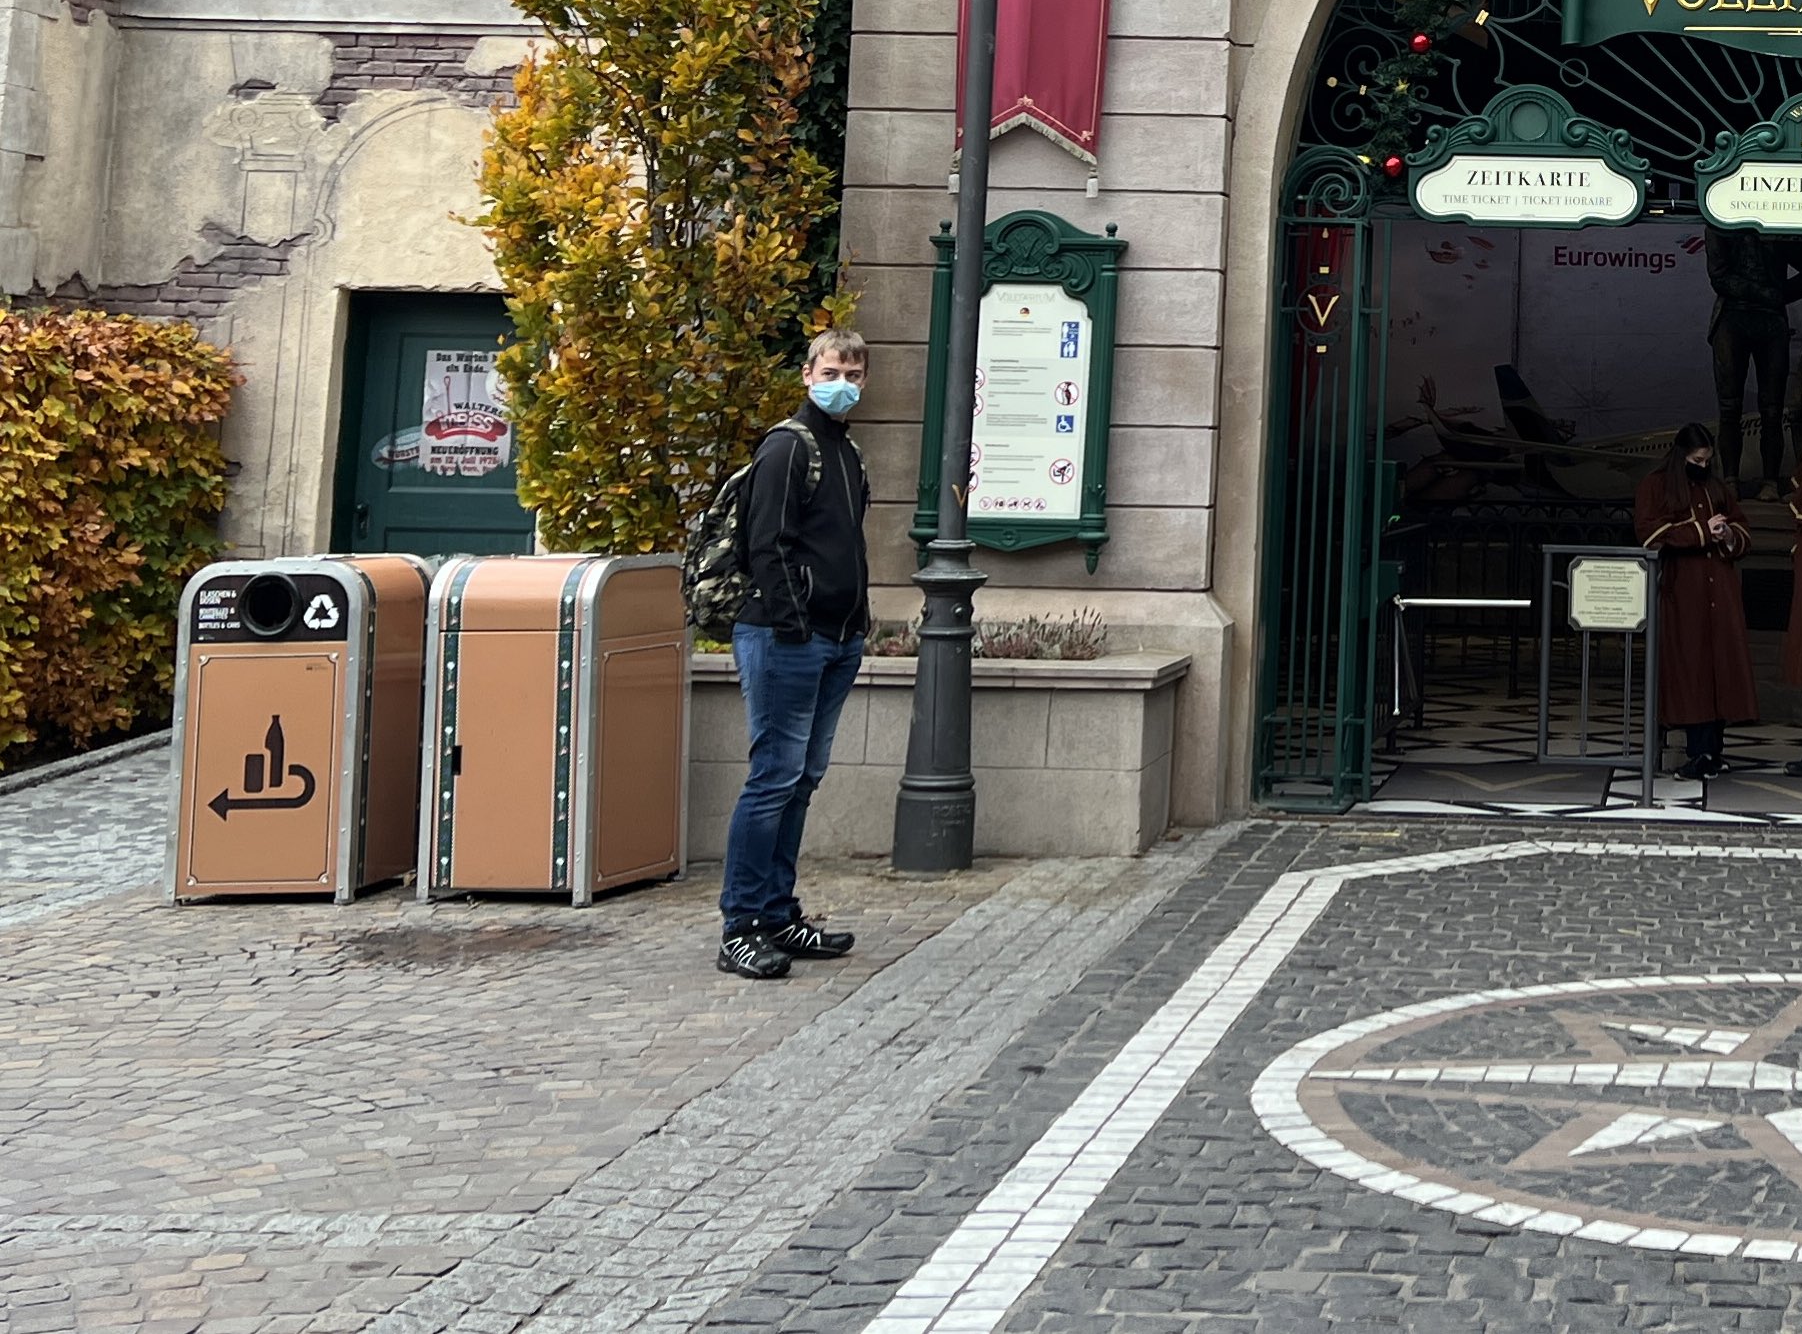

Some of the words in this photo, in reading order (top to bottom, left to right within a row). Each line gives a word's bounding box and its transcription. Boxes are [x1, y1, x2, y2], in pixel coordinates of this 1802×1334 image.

[1466, 170, 1591, 188] ZEITKARTE
[1442, 194, 1469, 204] TIME
[1471, 194, 1511, 205] TICKET
[1522, 196, 1561, 206] TICKET
[1564, 196, 1612, 206] HORAIRE
[1729, 200, 1768, 211] SINGLE
[1553, 245, 1676, 274] Eurowings
